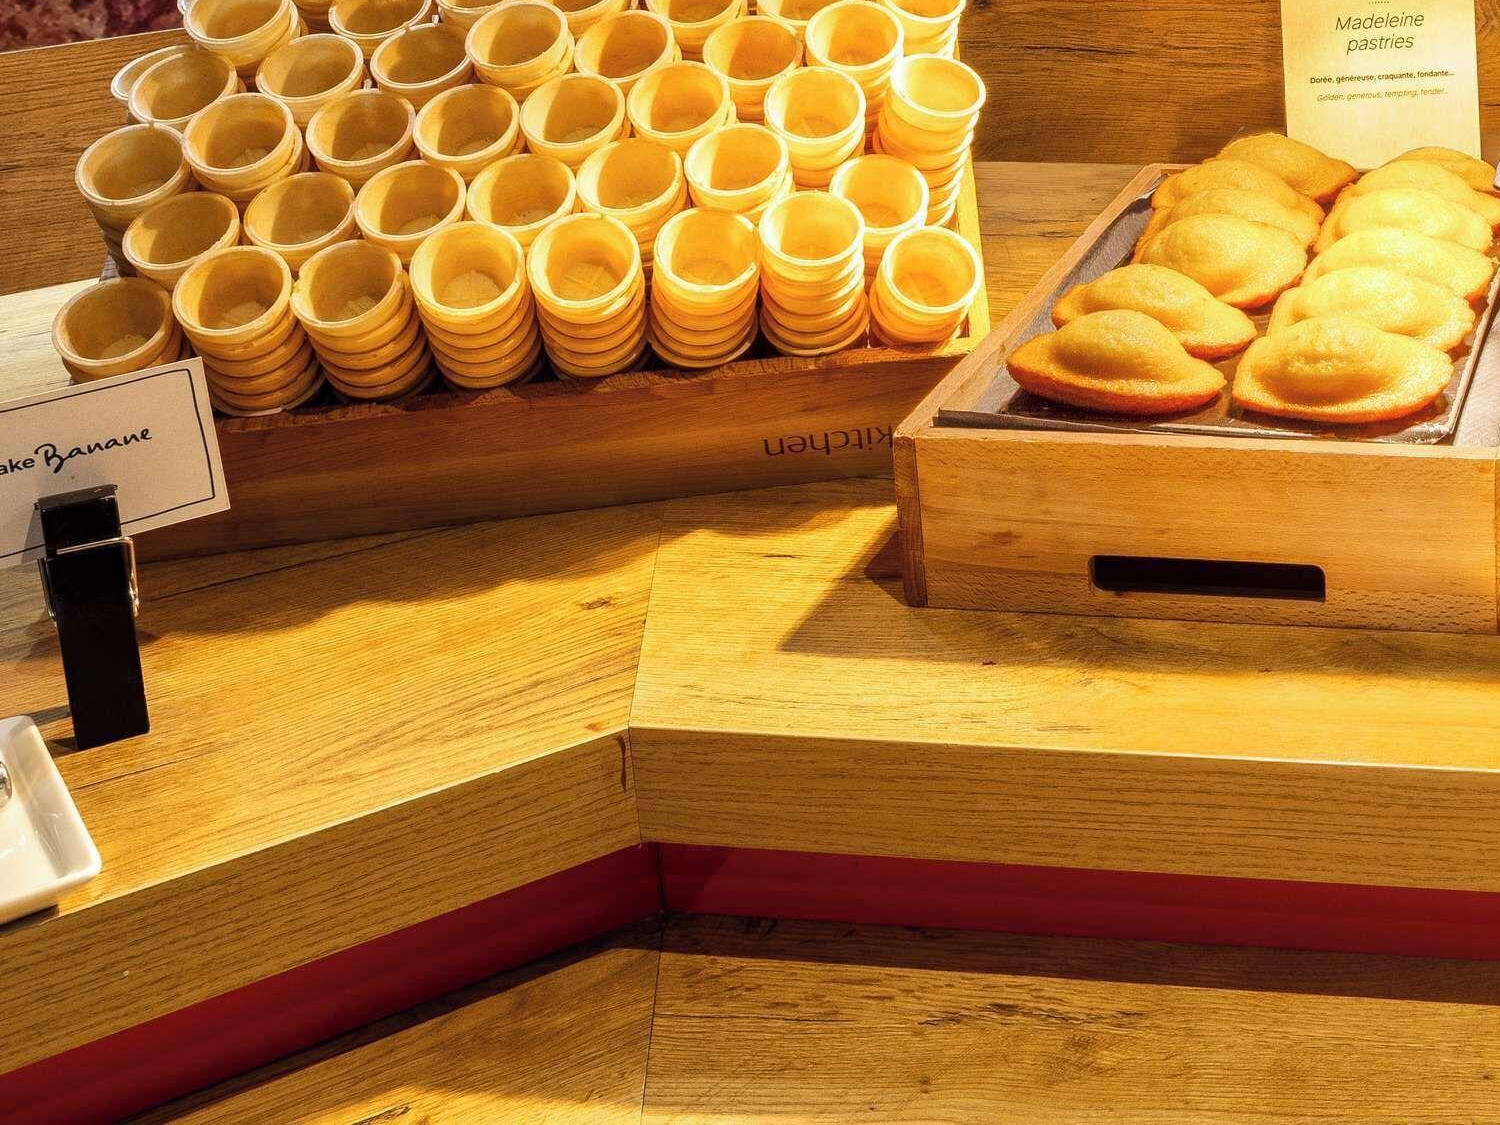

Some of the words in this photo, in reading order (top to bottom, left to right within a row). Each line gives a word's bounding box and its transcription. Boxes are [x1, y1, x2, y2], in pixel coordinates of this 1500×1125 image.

[1335, 11, 1425, 31] Madeleine
[1346, 33, 1415, 55] pastries
[1310, 76, 1335, 84] Dorée,
[0, 457, 35, 476] ake
[34, 427, 153, 474] Banane
[764, 425, 893, 456] kitchen
